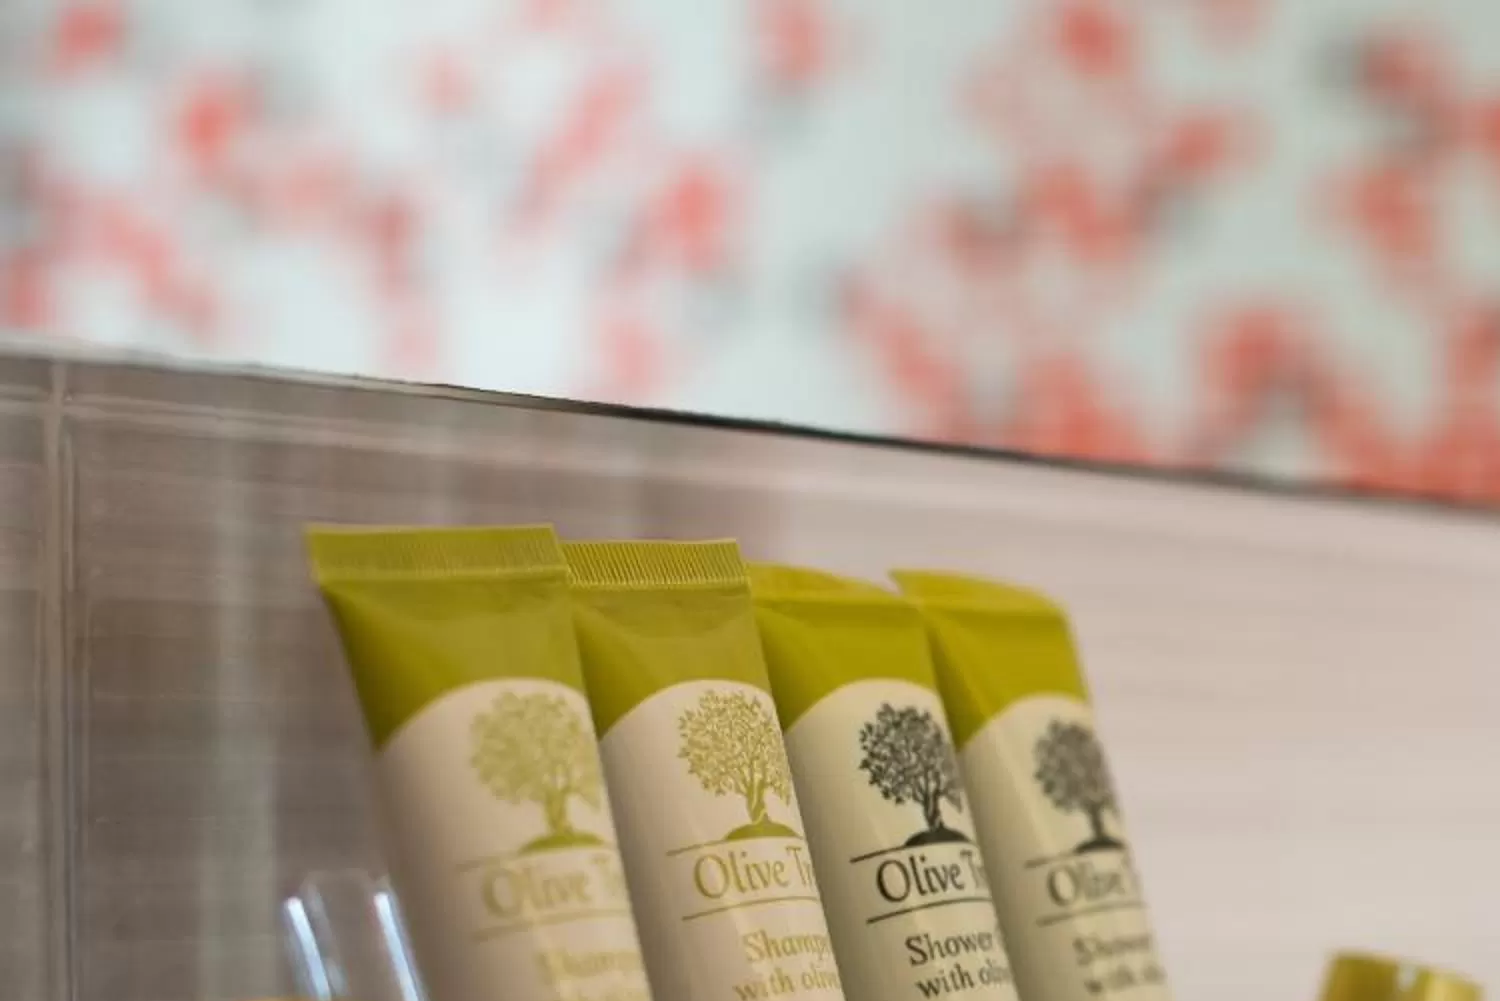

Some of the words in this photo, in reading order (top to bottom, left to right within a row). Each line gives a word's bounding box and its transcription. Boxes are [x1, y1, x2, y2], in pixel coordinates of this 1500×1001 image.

[694, 850, 789, 899] Olive
[876, 855, 965, 903] Olive
[732, 967, 795, 1001] with
[915, 962, 975, 999] with
